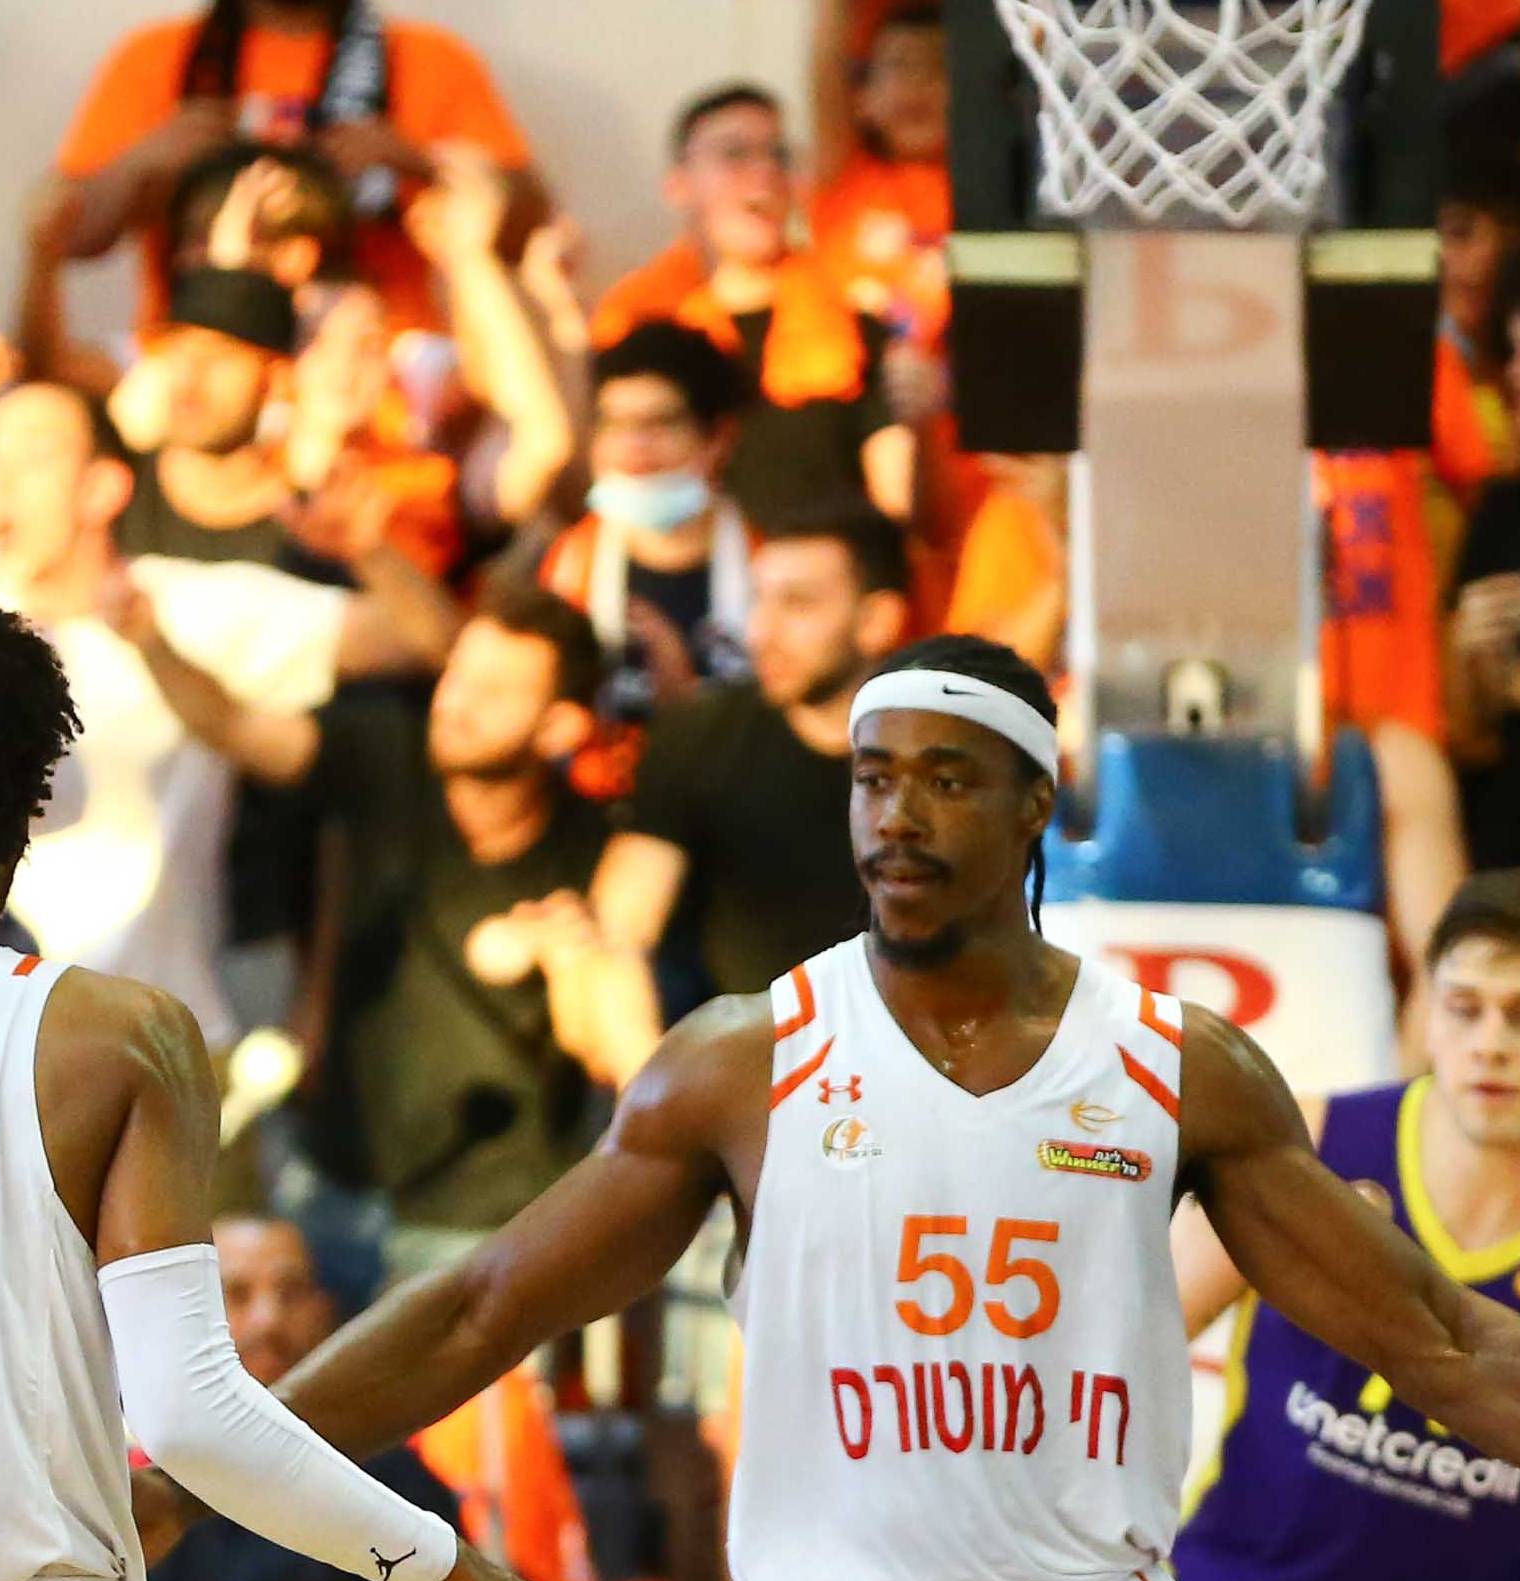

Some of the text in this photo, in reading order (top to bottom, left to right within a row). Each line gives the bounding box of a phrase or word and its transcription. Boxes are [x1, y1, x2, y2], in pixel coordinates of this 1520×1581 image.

[894, 1213, 1062, 1340] 55
[830, 1359, 1131, 1466] חי מוטורס
